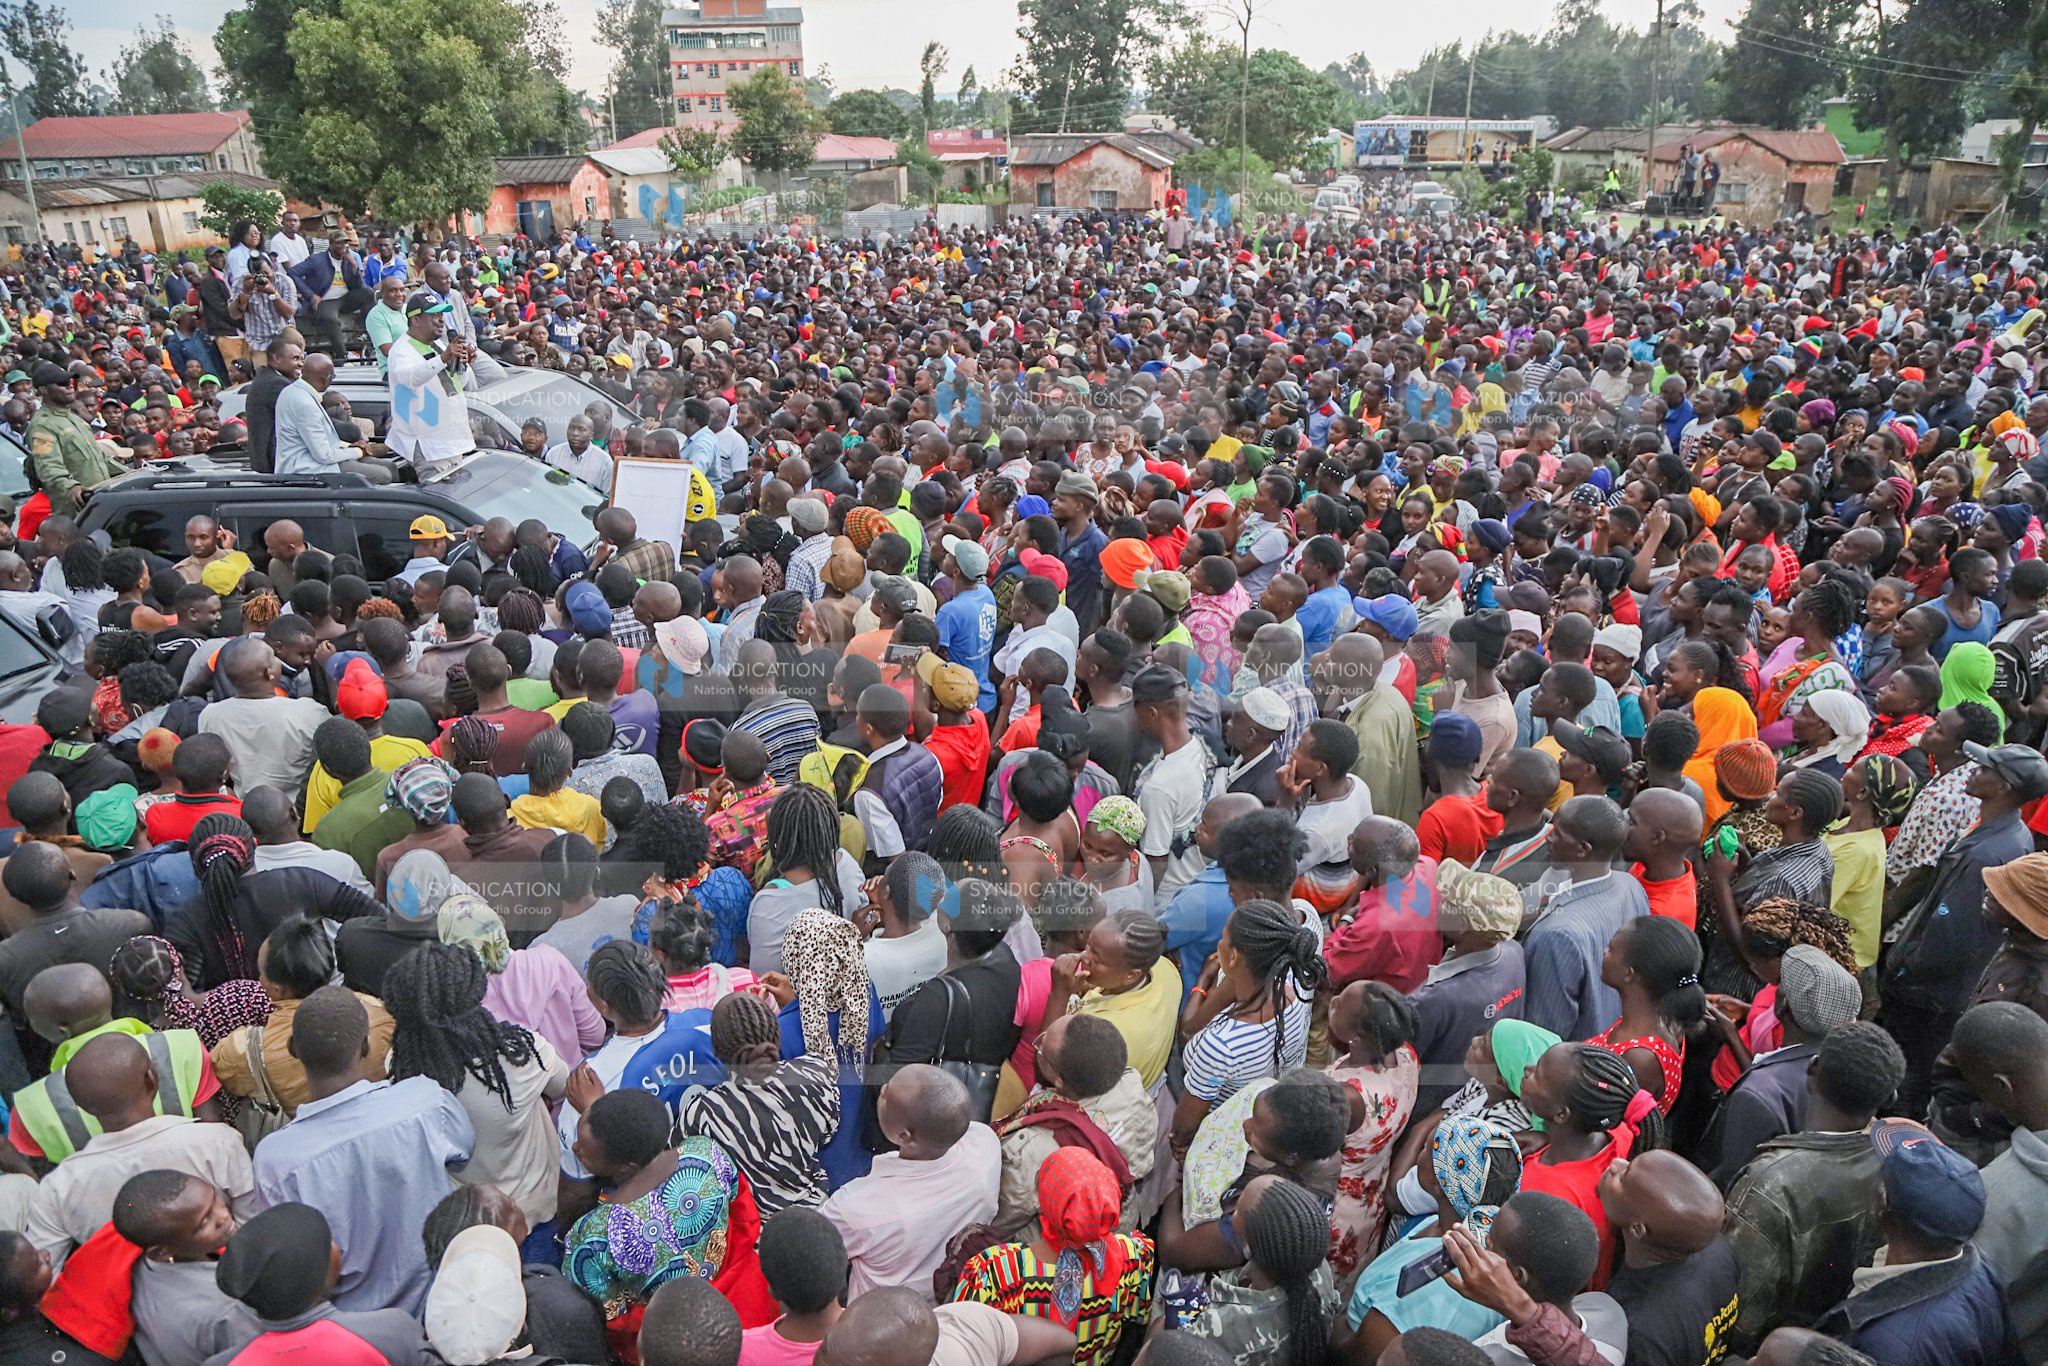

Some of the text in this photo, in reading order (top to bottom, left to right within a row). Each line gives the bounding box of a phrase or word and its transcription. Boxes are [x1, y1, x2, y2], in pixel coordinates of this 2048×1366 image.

[879, 984, 916, 1003] CHANGING
[1496, 987, 1522, 1012] BOSCH
[881, 1001, 898, 1010] FOR
